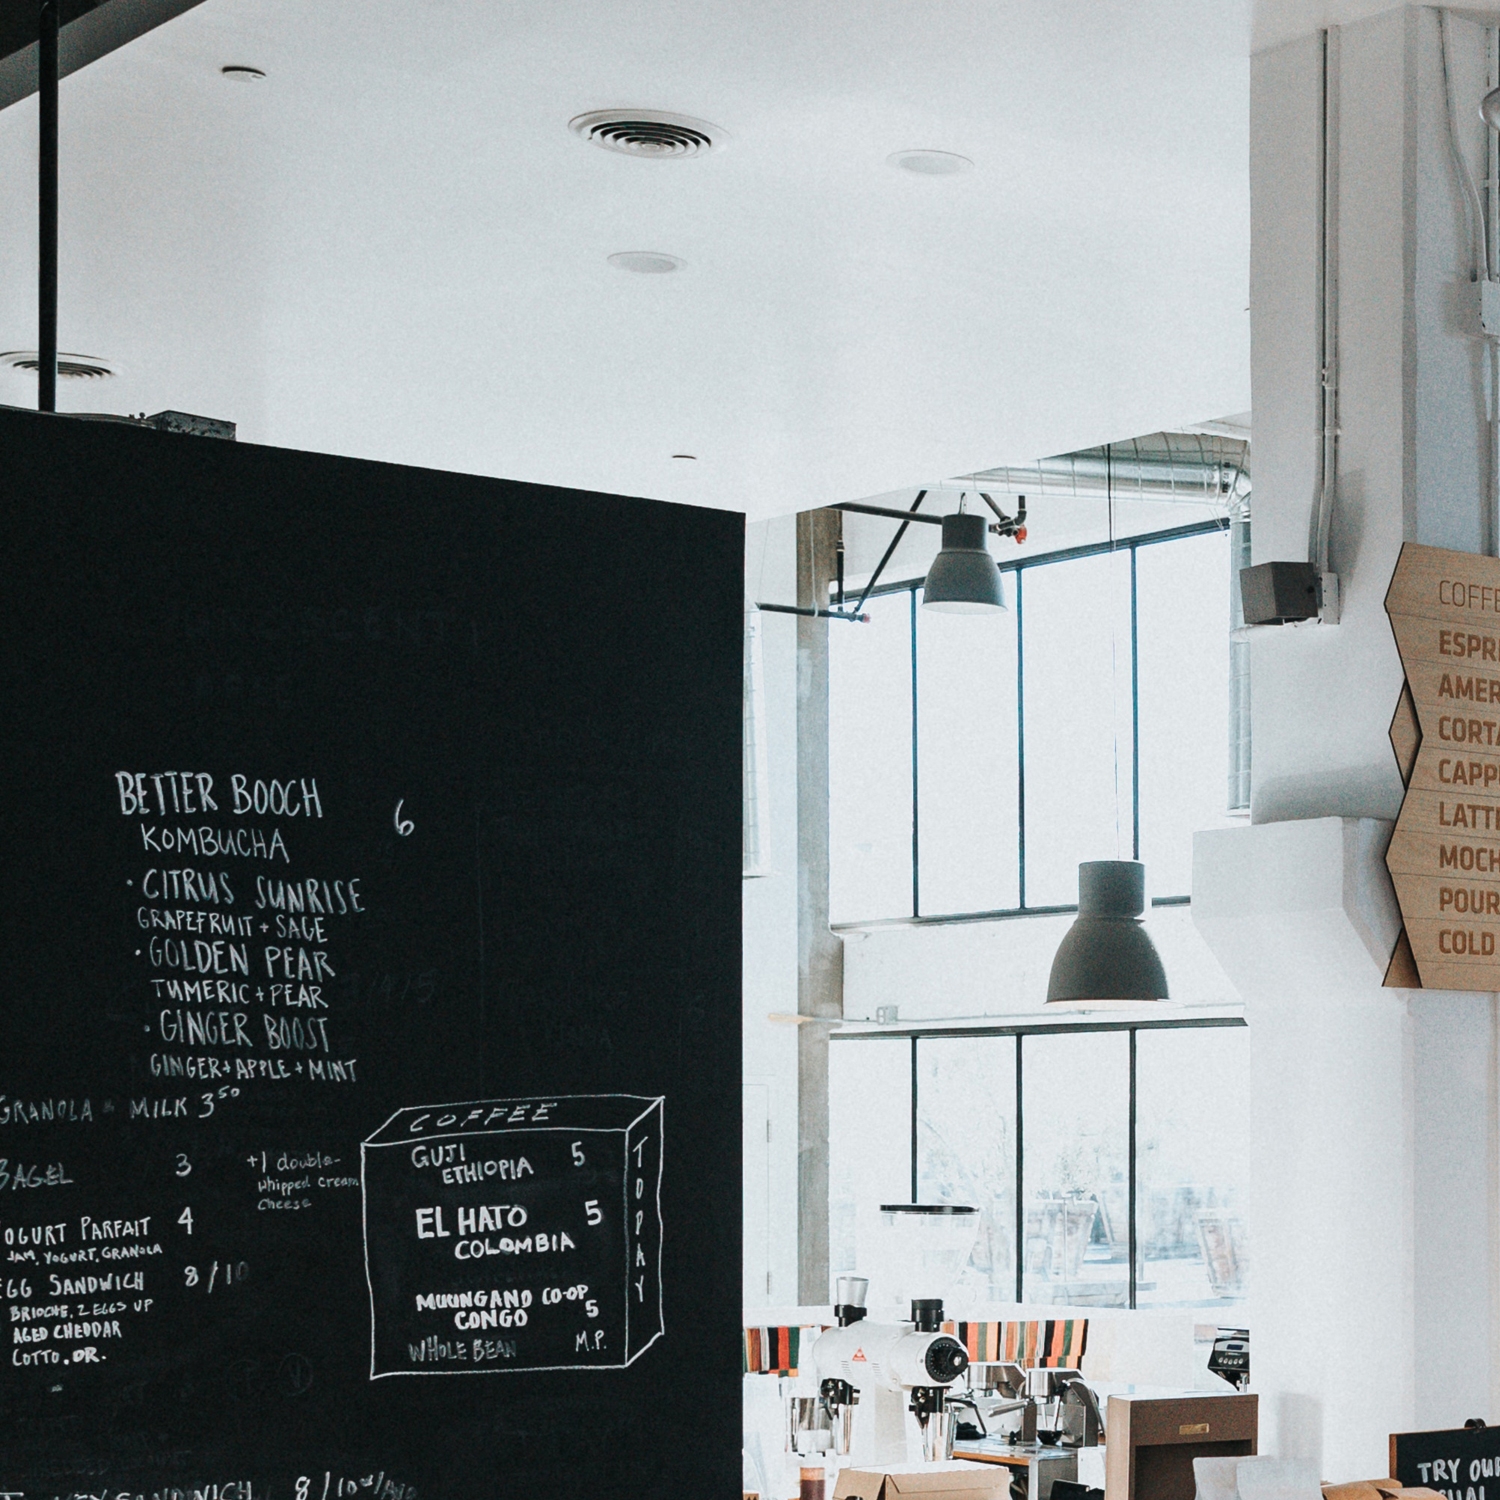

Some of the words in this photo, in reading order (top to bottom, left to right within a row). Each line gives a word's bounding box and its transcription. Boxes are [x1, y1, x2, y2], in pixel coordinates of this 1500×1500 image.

[115, 770, 219, 816] BETTER
[230, 773, 323, 818] BOOCH
[394, 799, 415, 837] 6
[140, 822, 290, 863] KOMBUCHA
[142, 868, 234, 904] CITRUS
[254, 875, 366, 915] SUNRISE
[1438, 887, 1500, 916] POUR
[137, 906, 253, 938] GRAPEFRUIT
[275, 915, 328, 943] SAGE
[1438, 929, 1495, 956] COLD
[149, 935, 250, 977] GOLDEN
[264, 946, 336, 983] PEAR
[150, 979, 251, 1004] TUMERIC
[270, 985, 329, 1009] PEAR
[160, 1009, 253, 1048] GINGER
[263, 1013, 329, 1053] BOOST
[150, 1053, 222, 1080] GINGER
[236, 1059, 290, 1081] APPLE
[308, 1059, 357, 1083] MINT
[130, 1096, 188, 1119] MILK
[409, 1102, 558, 1133] COFFEE
[175, 1152, 193, 1178] 3
[410, 1143, 466, 1169] GUJI
[571, 1140, 585, 1167] 5
[441, 1155, 535, 1185] ETHIOPIA
[257, 1175, 311, 1197] whipped
[3, 1223, 67, 1246] OGURT
[80, 1216, 152, 1241] PARFAIT
[177, 1205, 194, 1235] 4
[415, 1205, 451, 1239] EL
[457, 1203, 529, 1236] HATO
[584, 1198, 603, 1226] 5
[632, 1135, 649, 1303] TODAY
[101, 1243, 163, 1260] GRANOLA
[454, 1231, 576, 1261] COLOMBIA
[49, 1271, 145, 1297] SANDWICH
[541, 1284, 589, 1306] CO-OP
[77, 1304, 91, 1316] 2
[93, 1300, 127, 1316] EGGS
[133, 1298, 154, 1313] UP
[454, 1308, 529, 1331] CONGO
[585, 1300, 600, 1318] 5
[13, 1327, 49, 1344] AGED
[53, 1320, 123, 1339] CHEDDAR
[408, 1334, 468, 1363] WHOLE
[472, 1338, 518, 1363] BEAN
[1417, 1457, 1461, 1484] TRY
